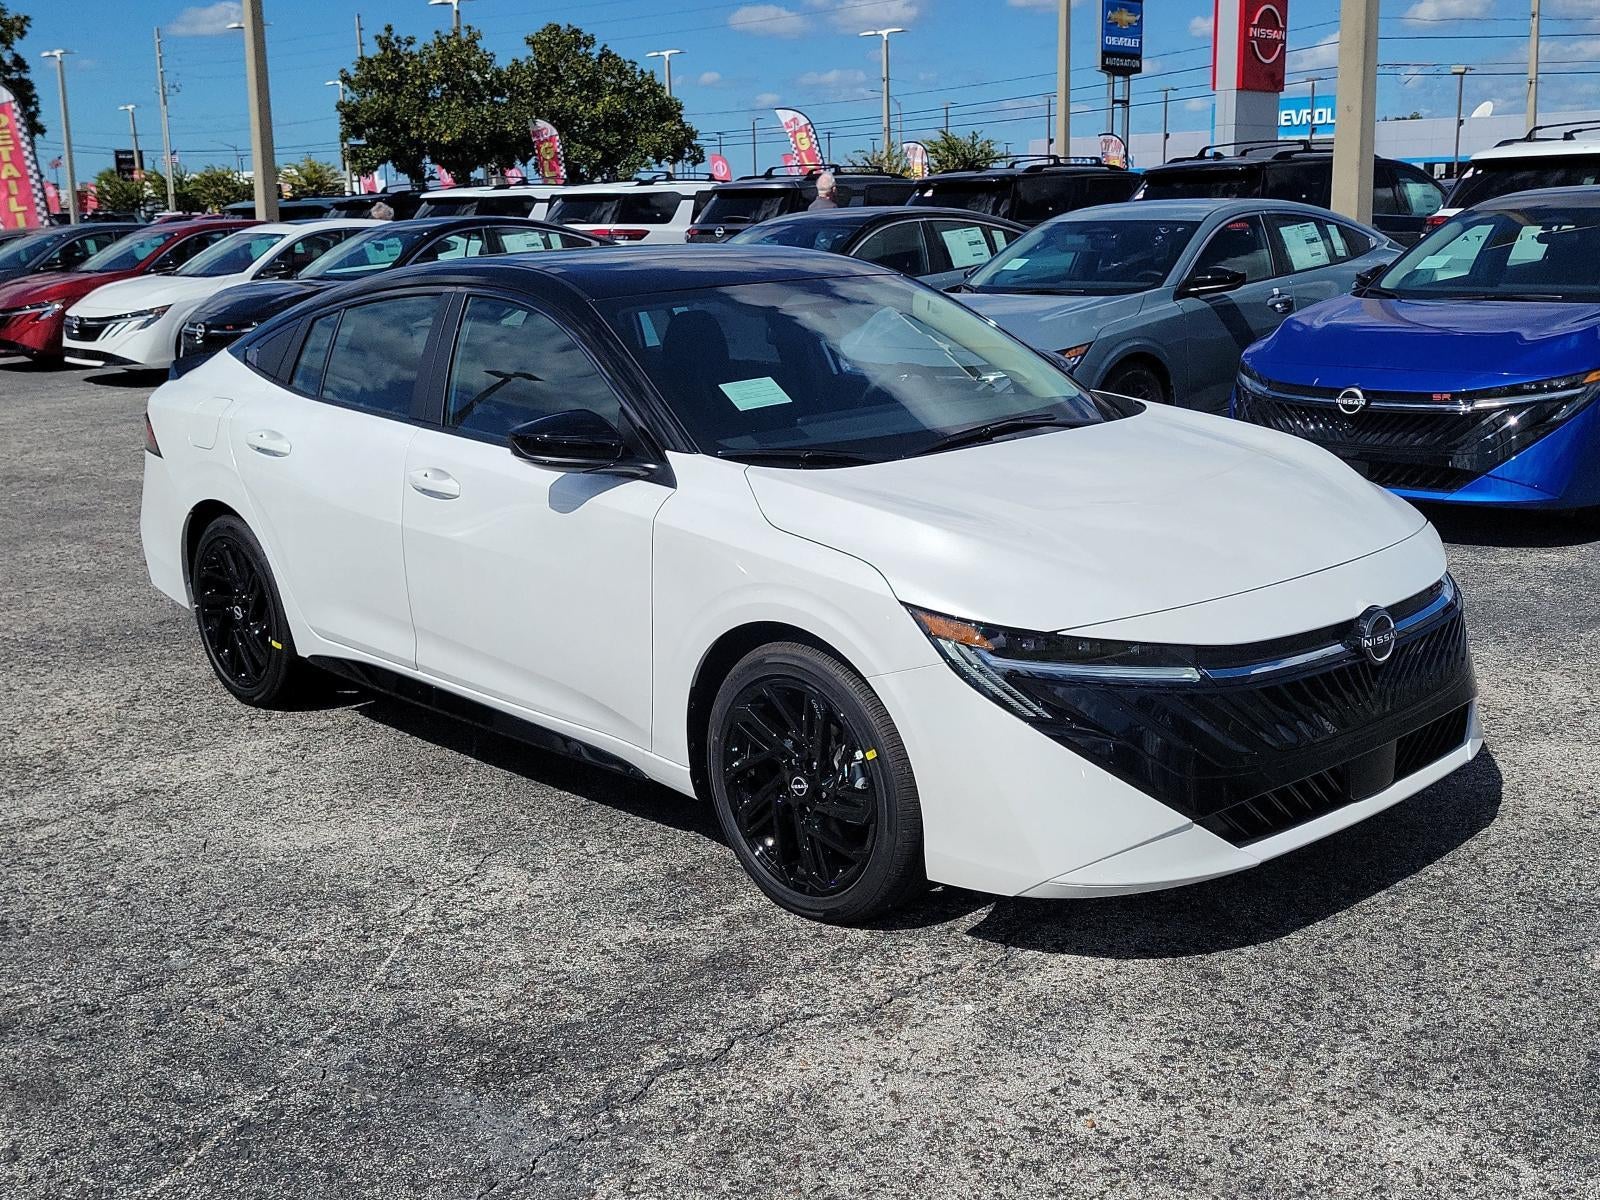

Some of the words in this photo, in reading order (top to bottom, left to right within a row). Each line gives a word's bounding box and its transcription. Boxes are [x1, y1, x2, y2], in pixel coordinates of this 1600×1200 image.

[1249, 27, 1285, 40] NISSAN
[1105, 36, 1140, 47] CHEVROLET
[1105, 57, 1140, 67] AUTONATION
[1335, 398, 1367, 406] NISSAN
[1432, 393, 1451, 401] SR
